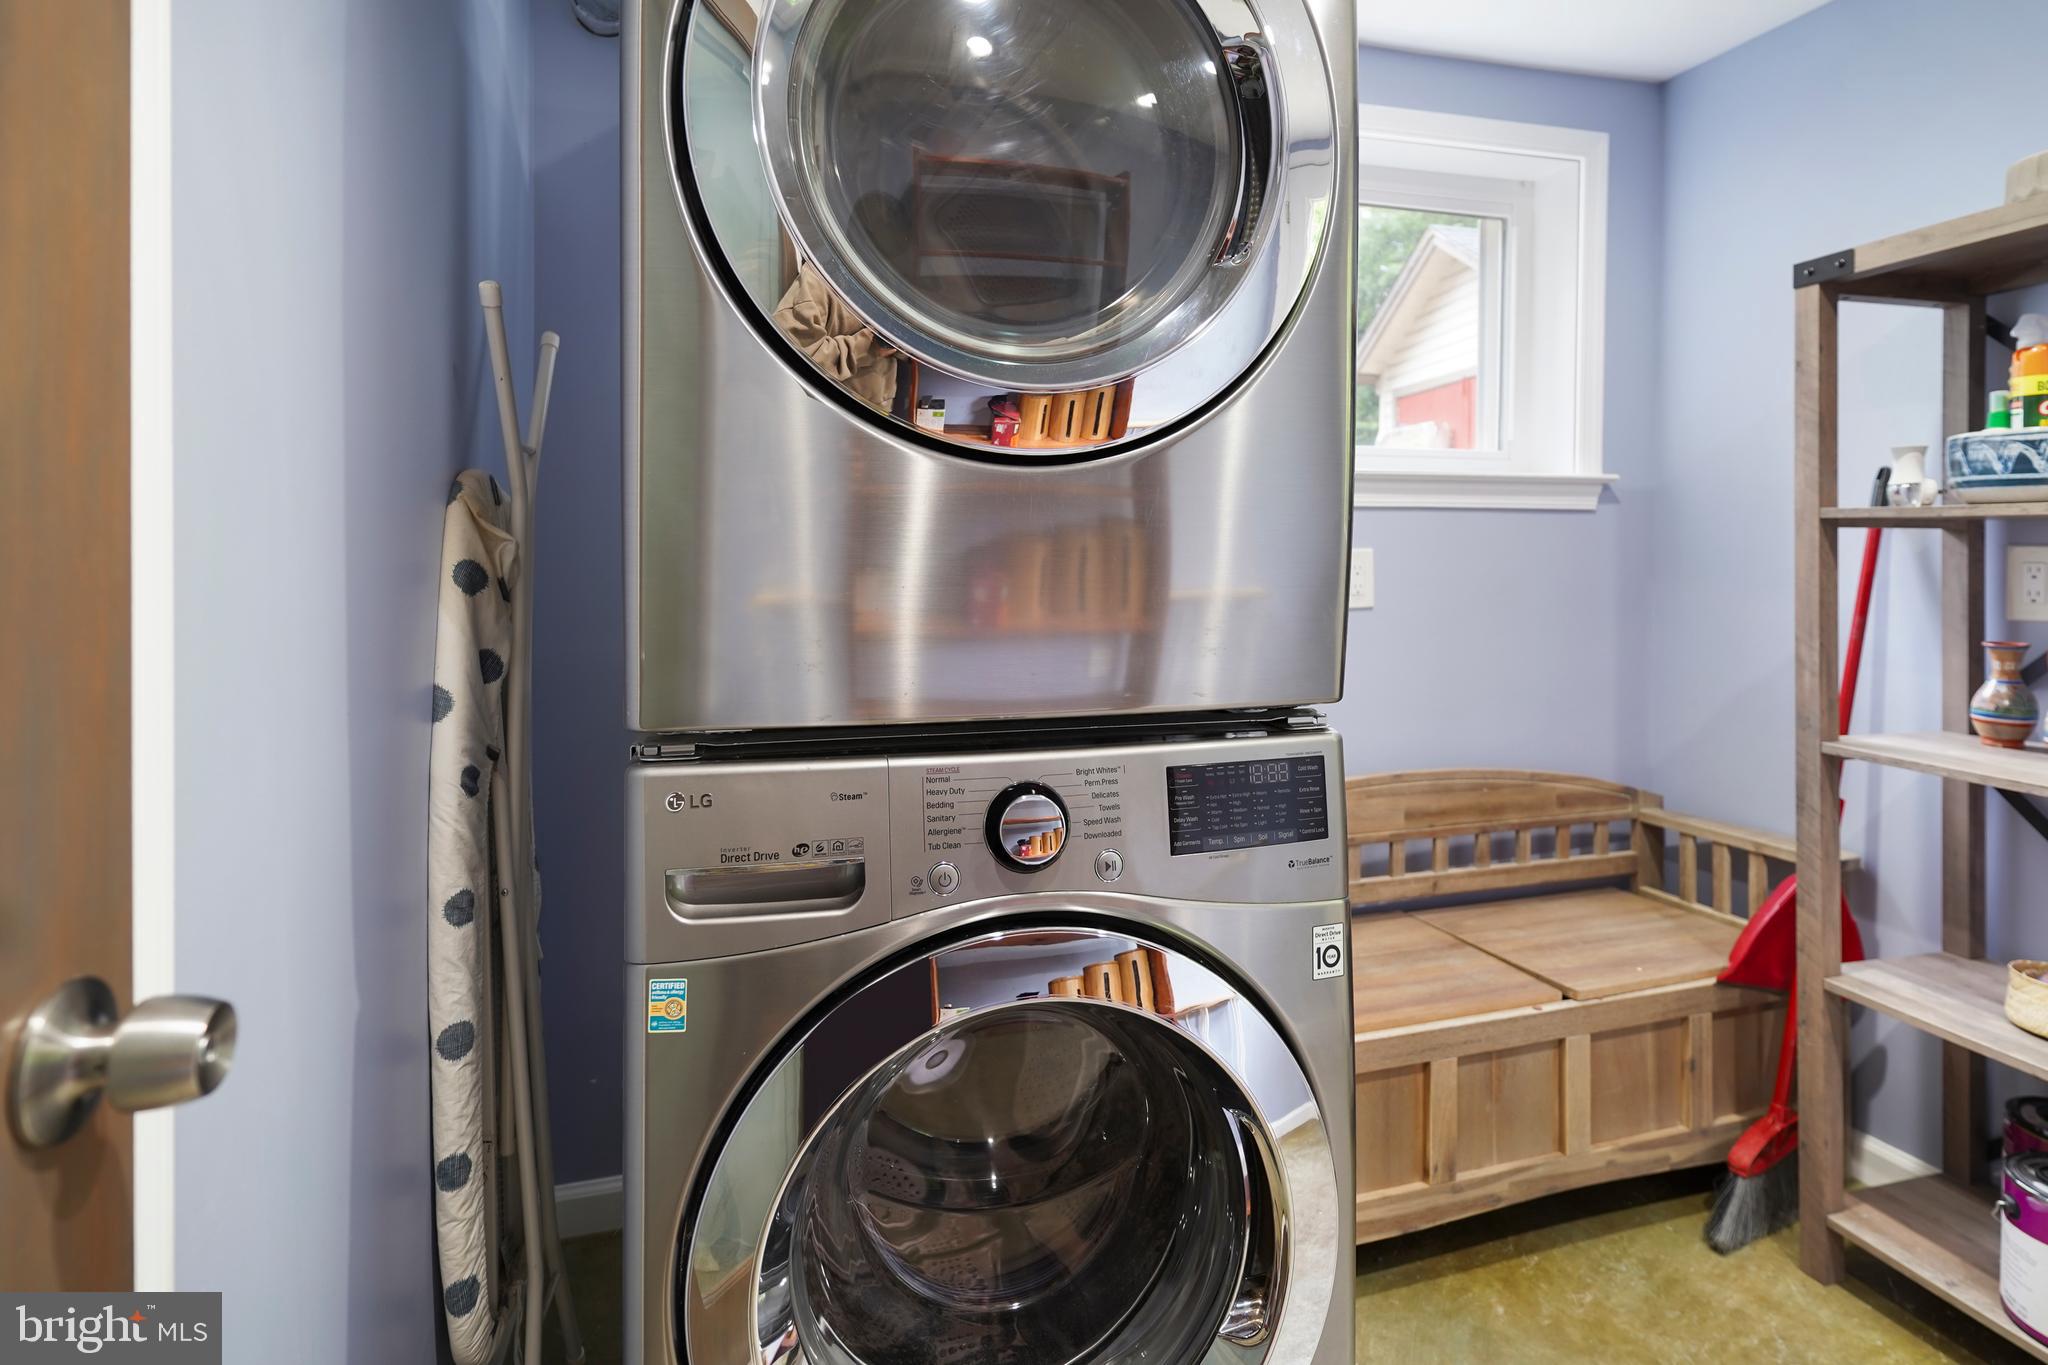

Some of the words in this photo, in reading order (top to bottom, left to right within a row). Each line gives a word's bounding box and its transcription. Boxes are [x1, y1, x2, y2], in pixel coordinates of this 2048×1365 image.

[1075, 768, 1095, 776] Bright
[926, 776, 950, 784] Normal
[926, 788, 948, 796] Heavy
[949, 787, 965, 795] Duty
[1091, 791, 1120, 799] Delicates
[689, 794, 713, 809] LG
[926, 801, 955, 809] Bedding
[926, 814, 956, 823] Sanitary
[1083, 818, 1103, 826] Speed
[1104, 816, 1122, 824] Wash
[1083, 829, 1122, 840] Downloaded
[1278, 831, 1294, 839] Signal
[1233, 835, 1246, 843] Spin
[720, 851, 751, 864] Direct
[753, 850, 780, 862] Drive
[1316, 944, 1341, 970] 10
[651, 982, 685, 990] CERTIFIED
